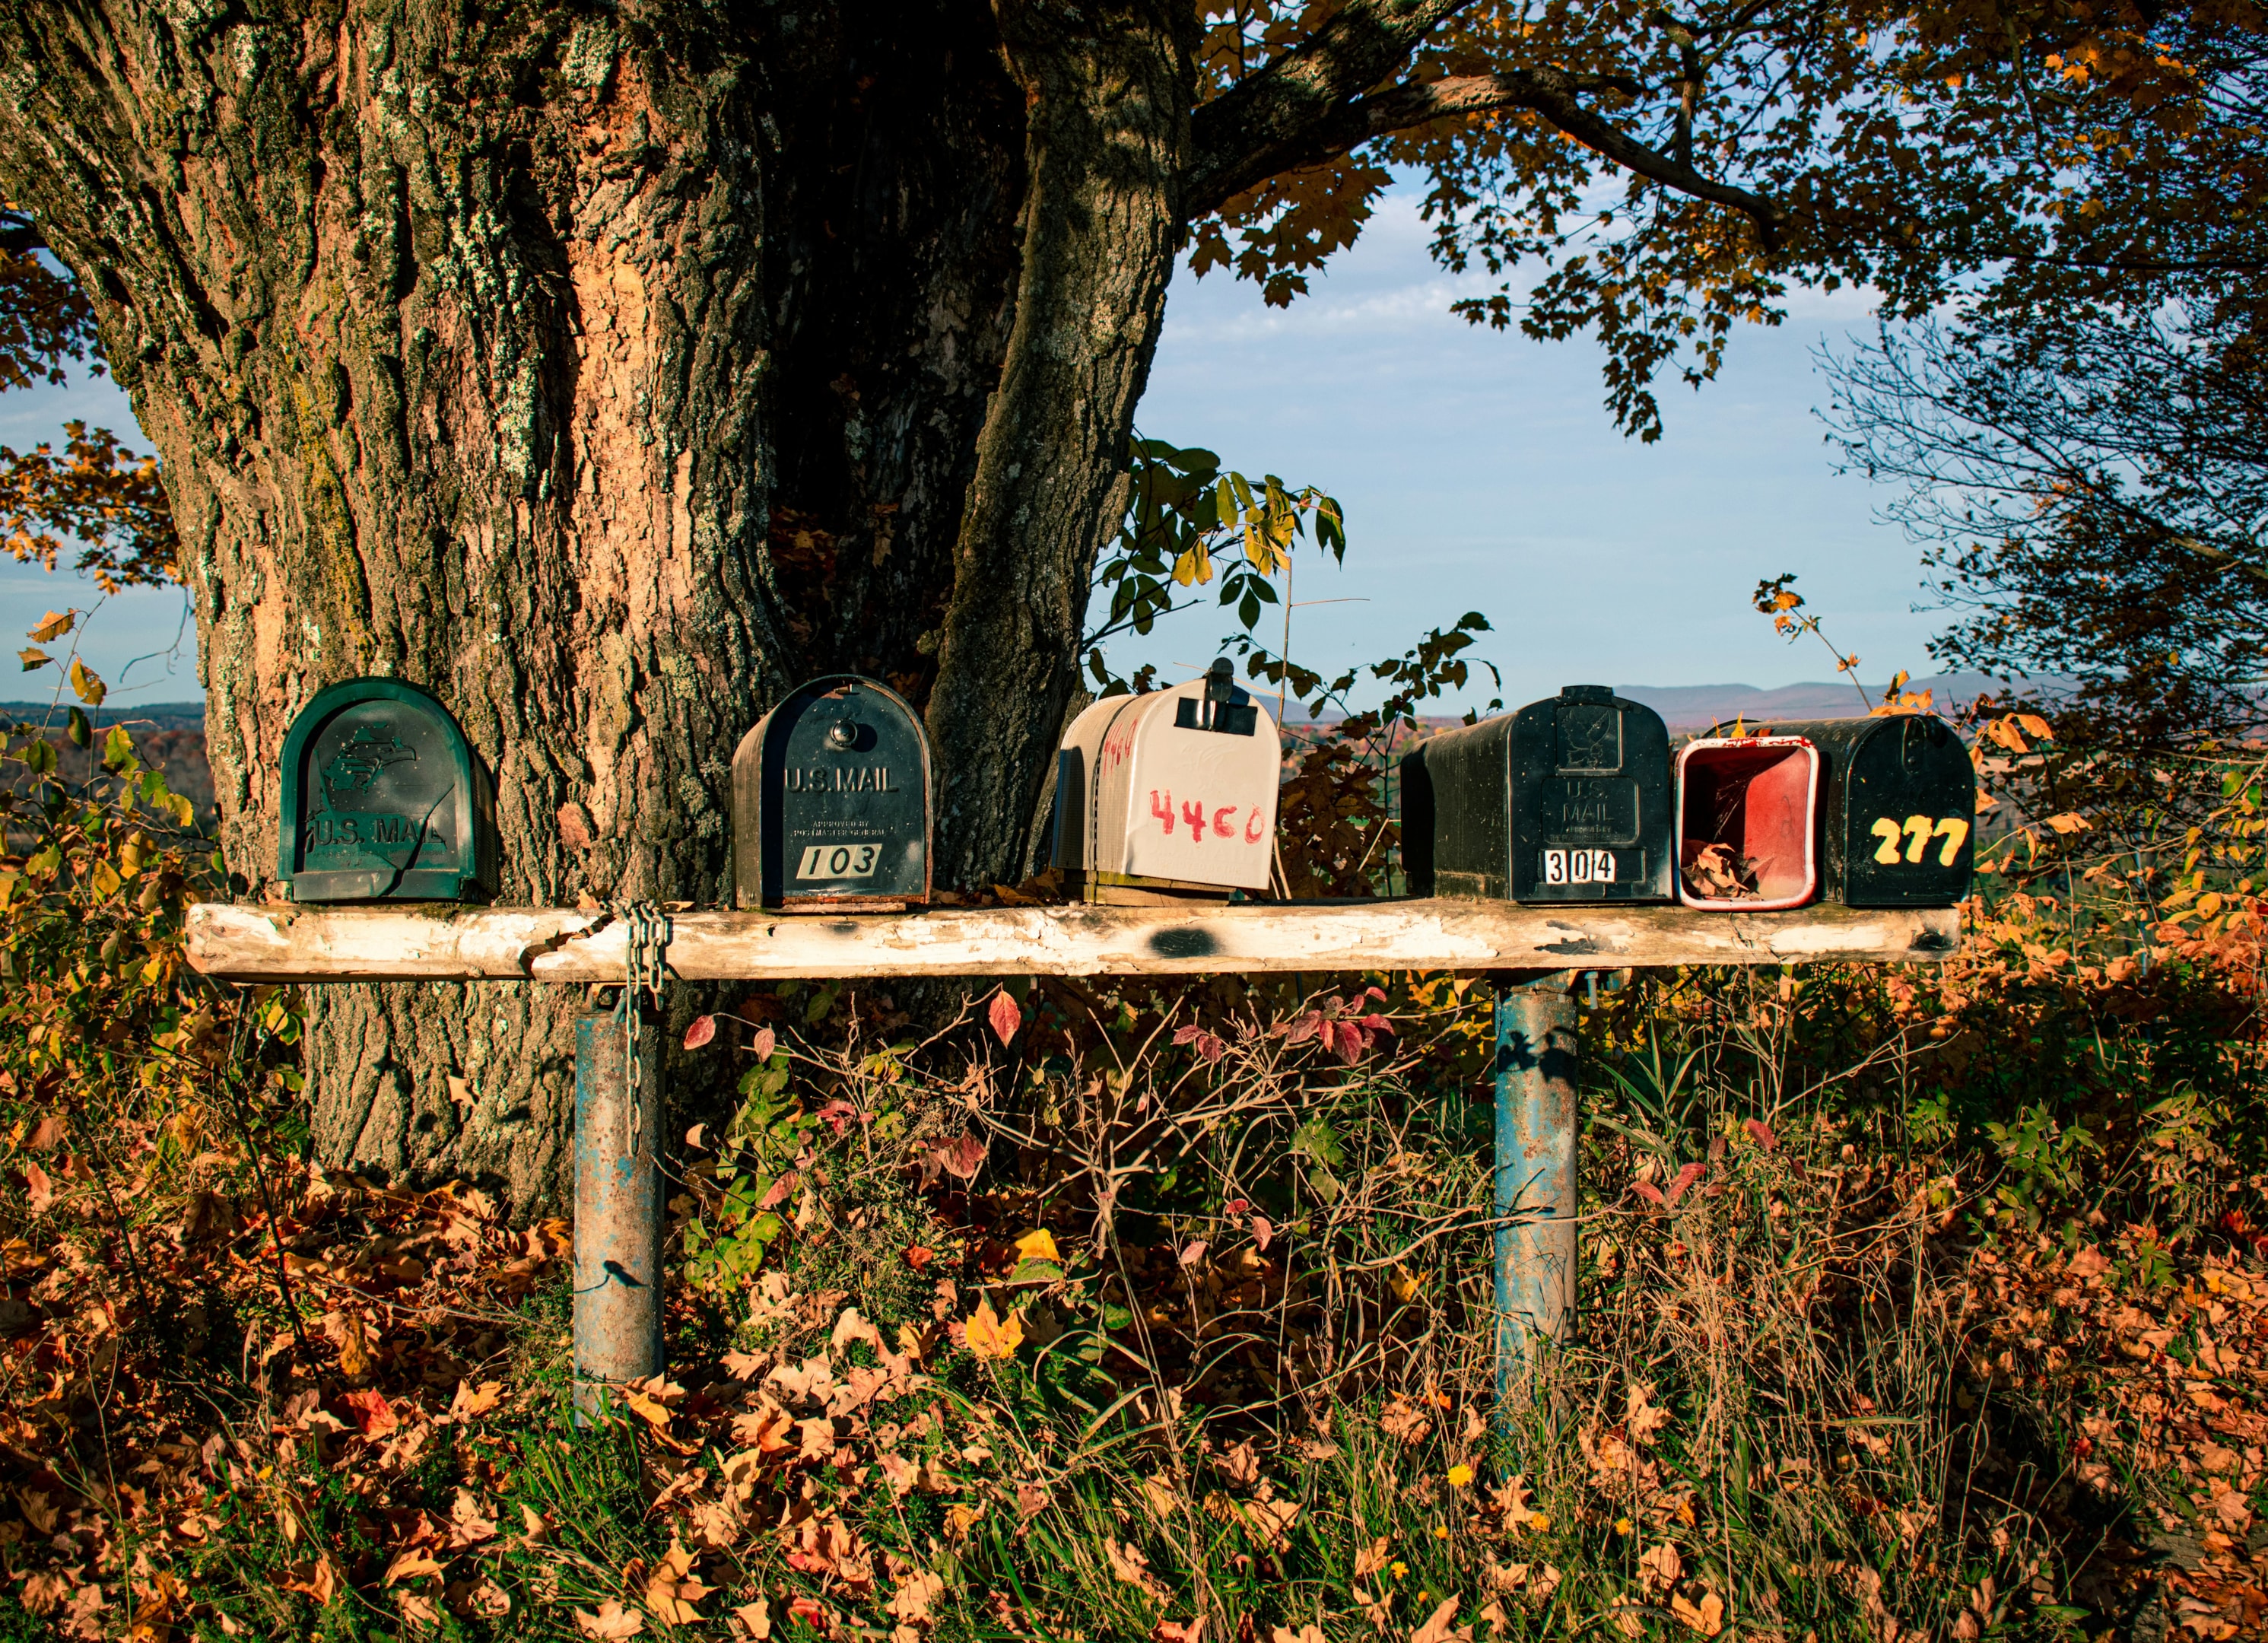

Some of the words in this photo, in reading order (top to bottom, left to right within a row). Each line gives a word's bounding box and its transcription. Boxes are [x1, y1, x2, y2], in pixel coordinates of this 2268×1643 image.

[784, 767, 834, 793] U.S.
[837, 767, 899, 792] MAIL
[1567, 780, 1609, 799] U.S.
[1150, 790, 1266, 846] 4460
[1563, 802, 1615, 822] MAIL
[314, 818, 365, 845] U.S.
[793, 828, 847, 837] POSTMASTER
[850, 828, 886, 837] GENERAL
[1871, 815, 1969, 867] 277
[808, 846, 875, 875] 103
[1549, 850, 1612, 882] 304
